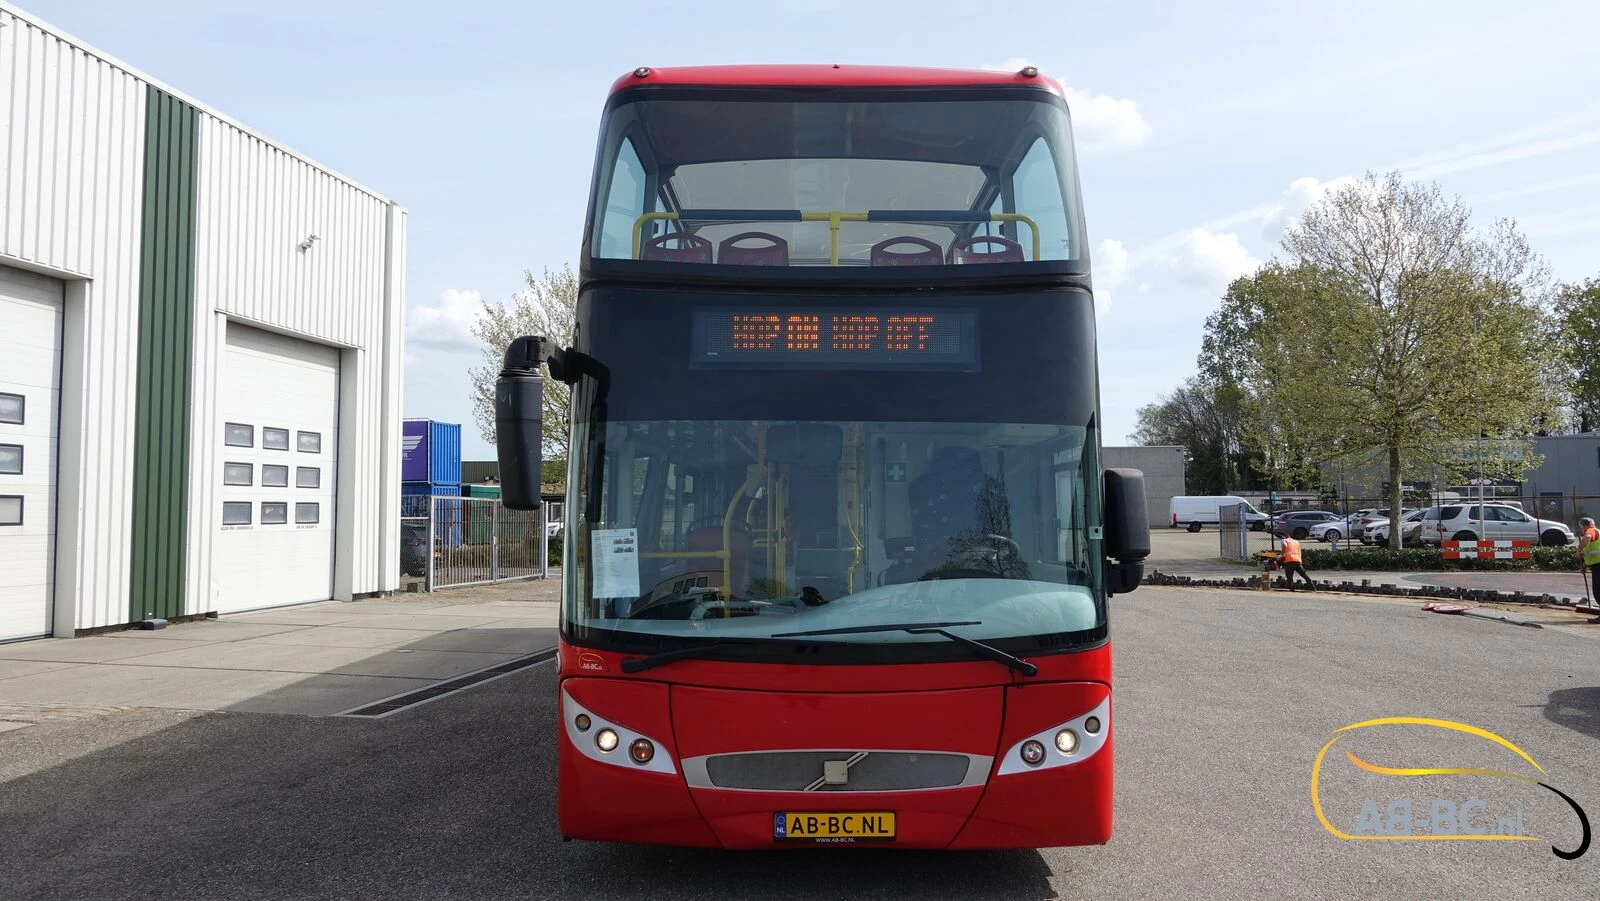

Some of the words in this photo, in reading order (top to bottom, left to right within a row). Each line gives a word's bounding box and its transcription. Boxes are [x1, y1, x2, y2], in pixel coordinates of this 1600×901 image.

[733, 315, 780, 350] HOP
[787, 315, 819, 350] ON
[832, 315, 879, 350] HOP
[887, 315, 934, 350] OFF
[790, 816, 889, 834] AB-BC.NL
